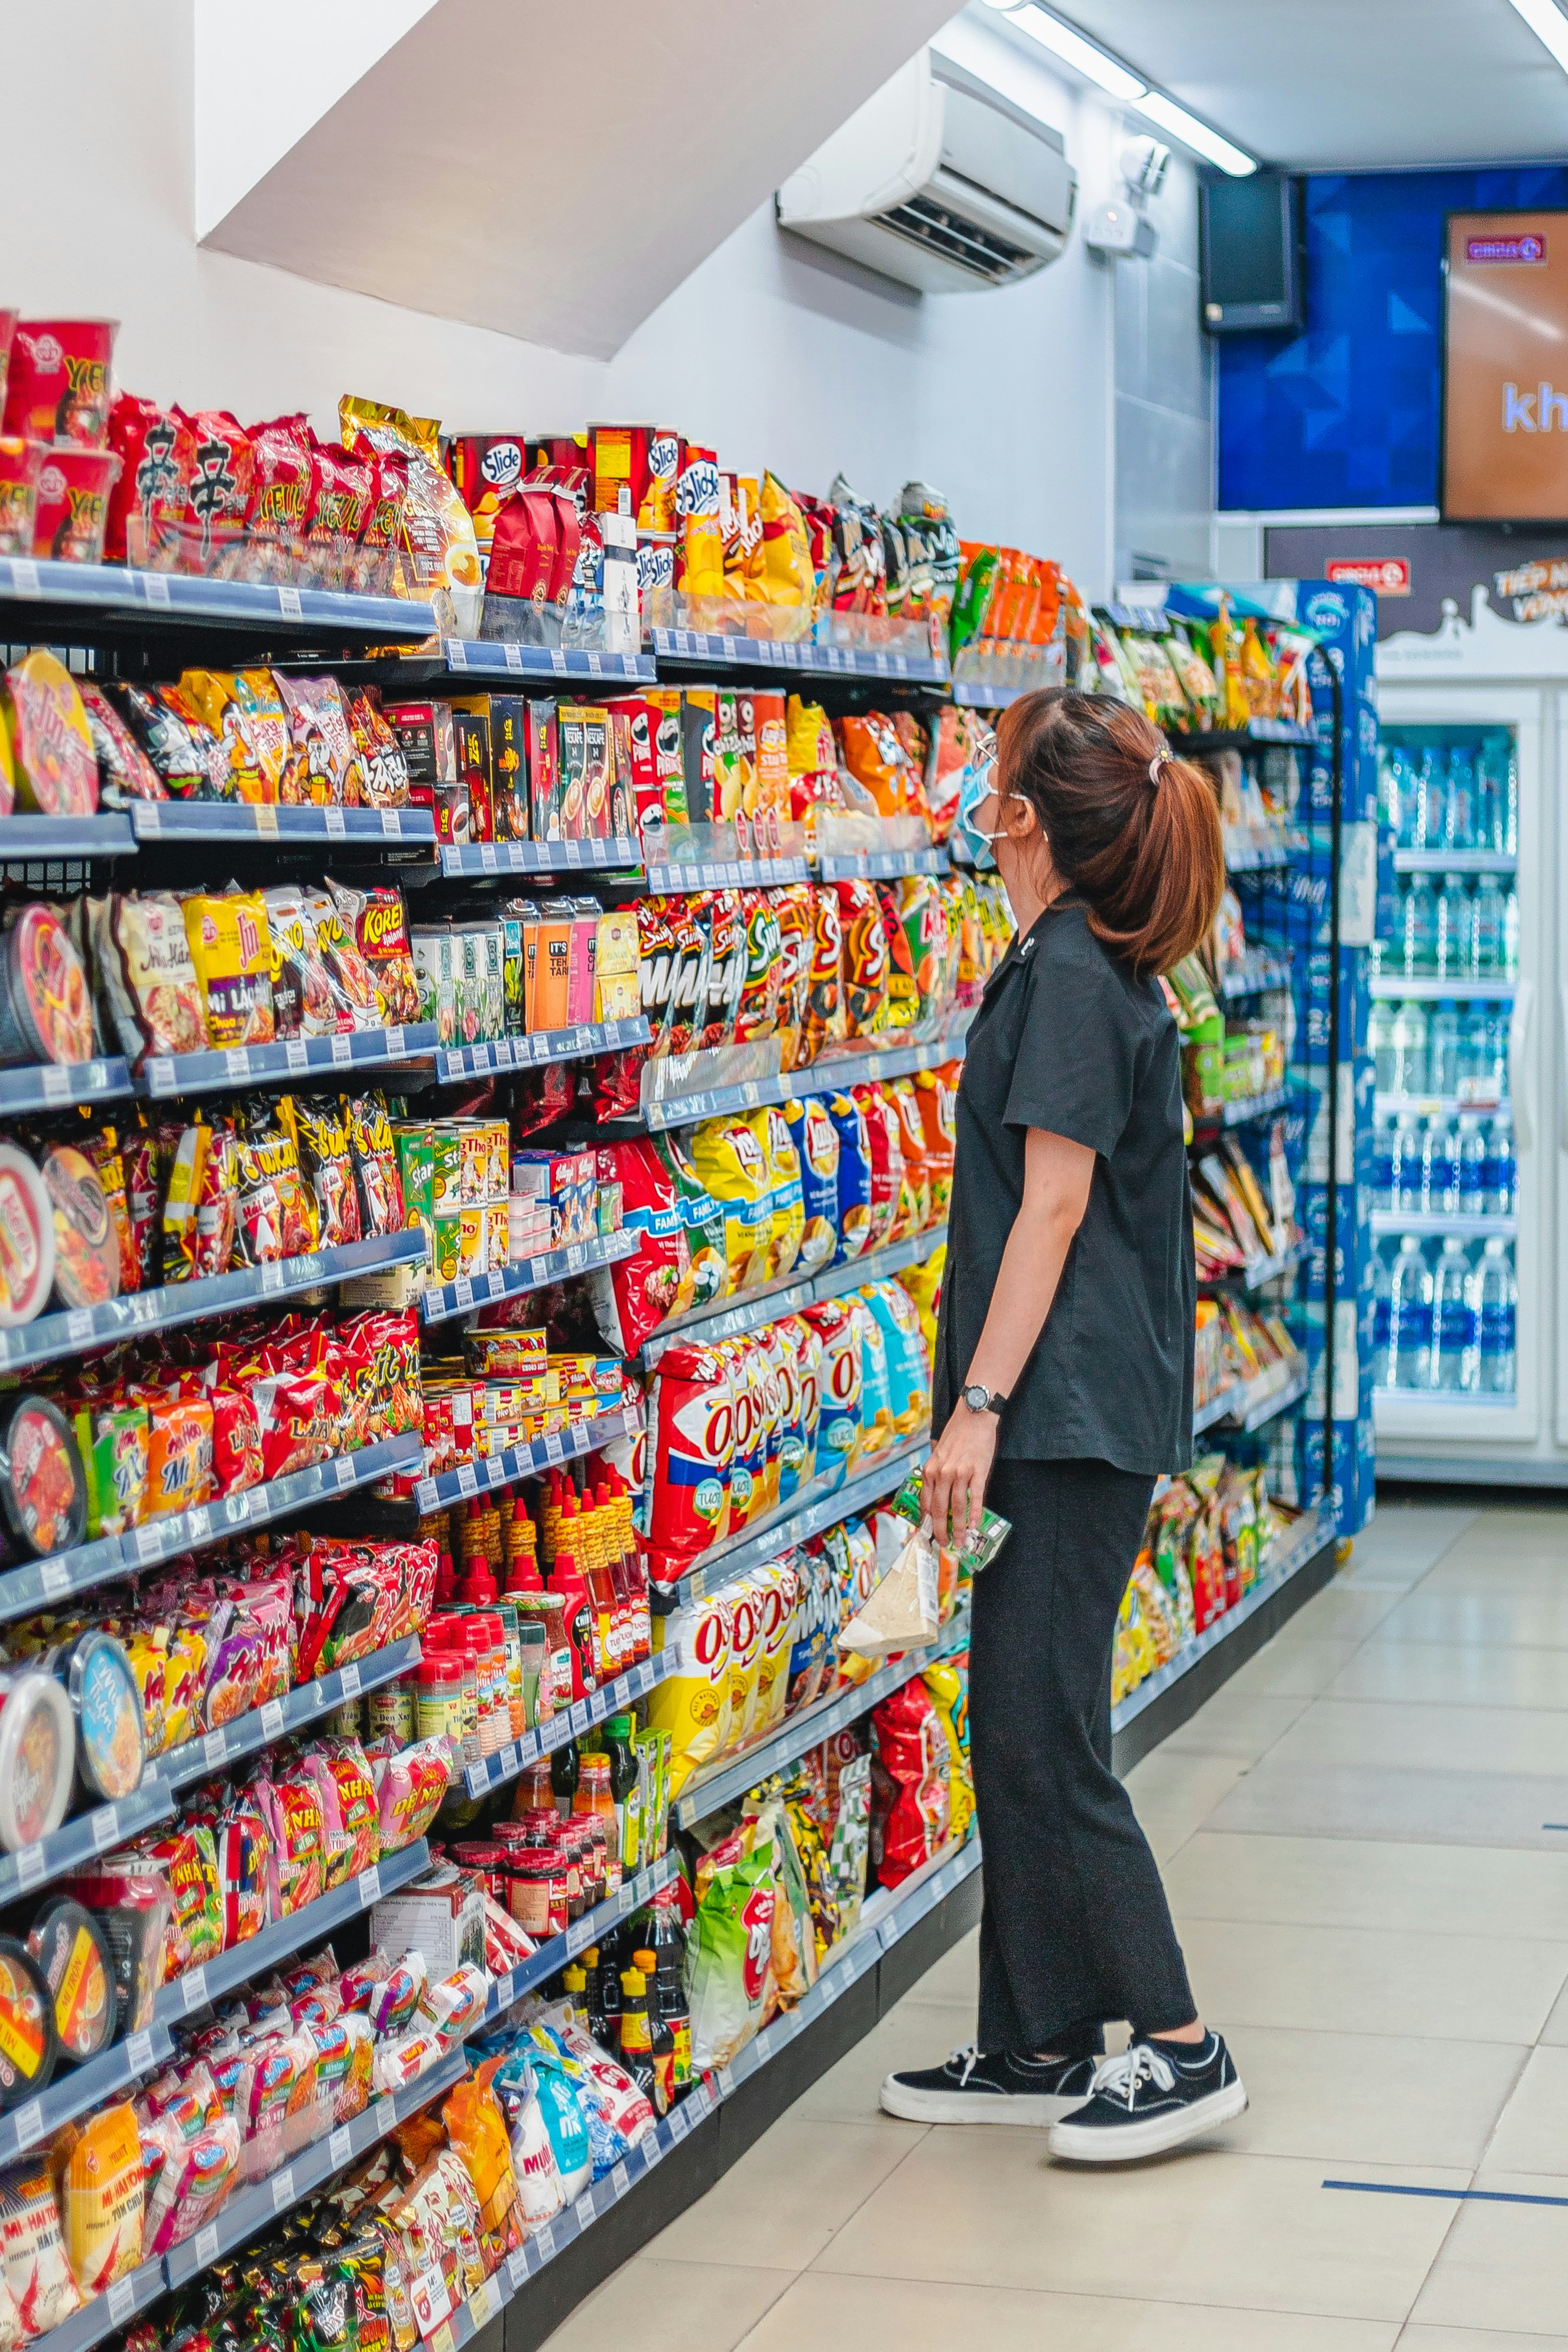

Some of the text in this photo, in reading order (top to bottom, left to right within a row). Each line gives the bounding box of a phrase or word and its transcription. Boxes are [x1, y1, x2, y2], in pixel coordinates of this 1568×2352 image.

[486, 450, 519, 483] Slide
[550, 942, 567, 953] IT'S
[550, 958, 567, 967] TEH
